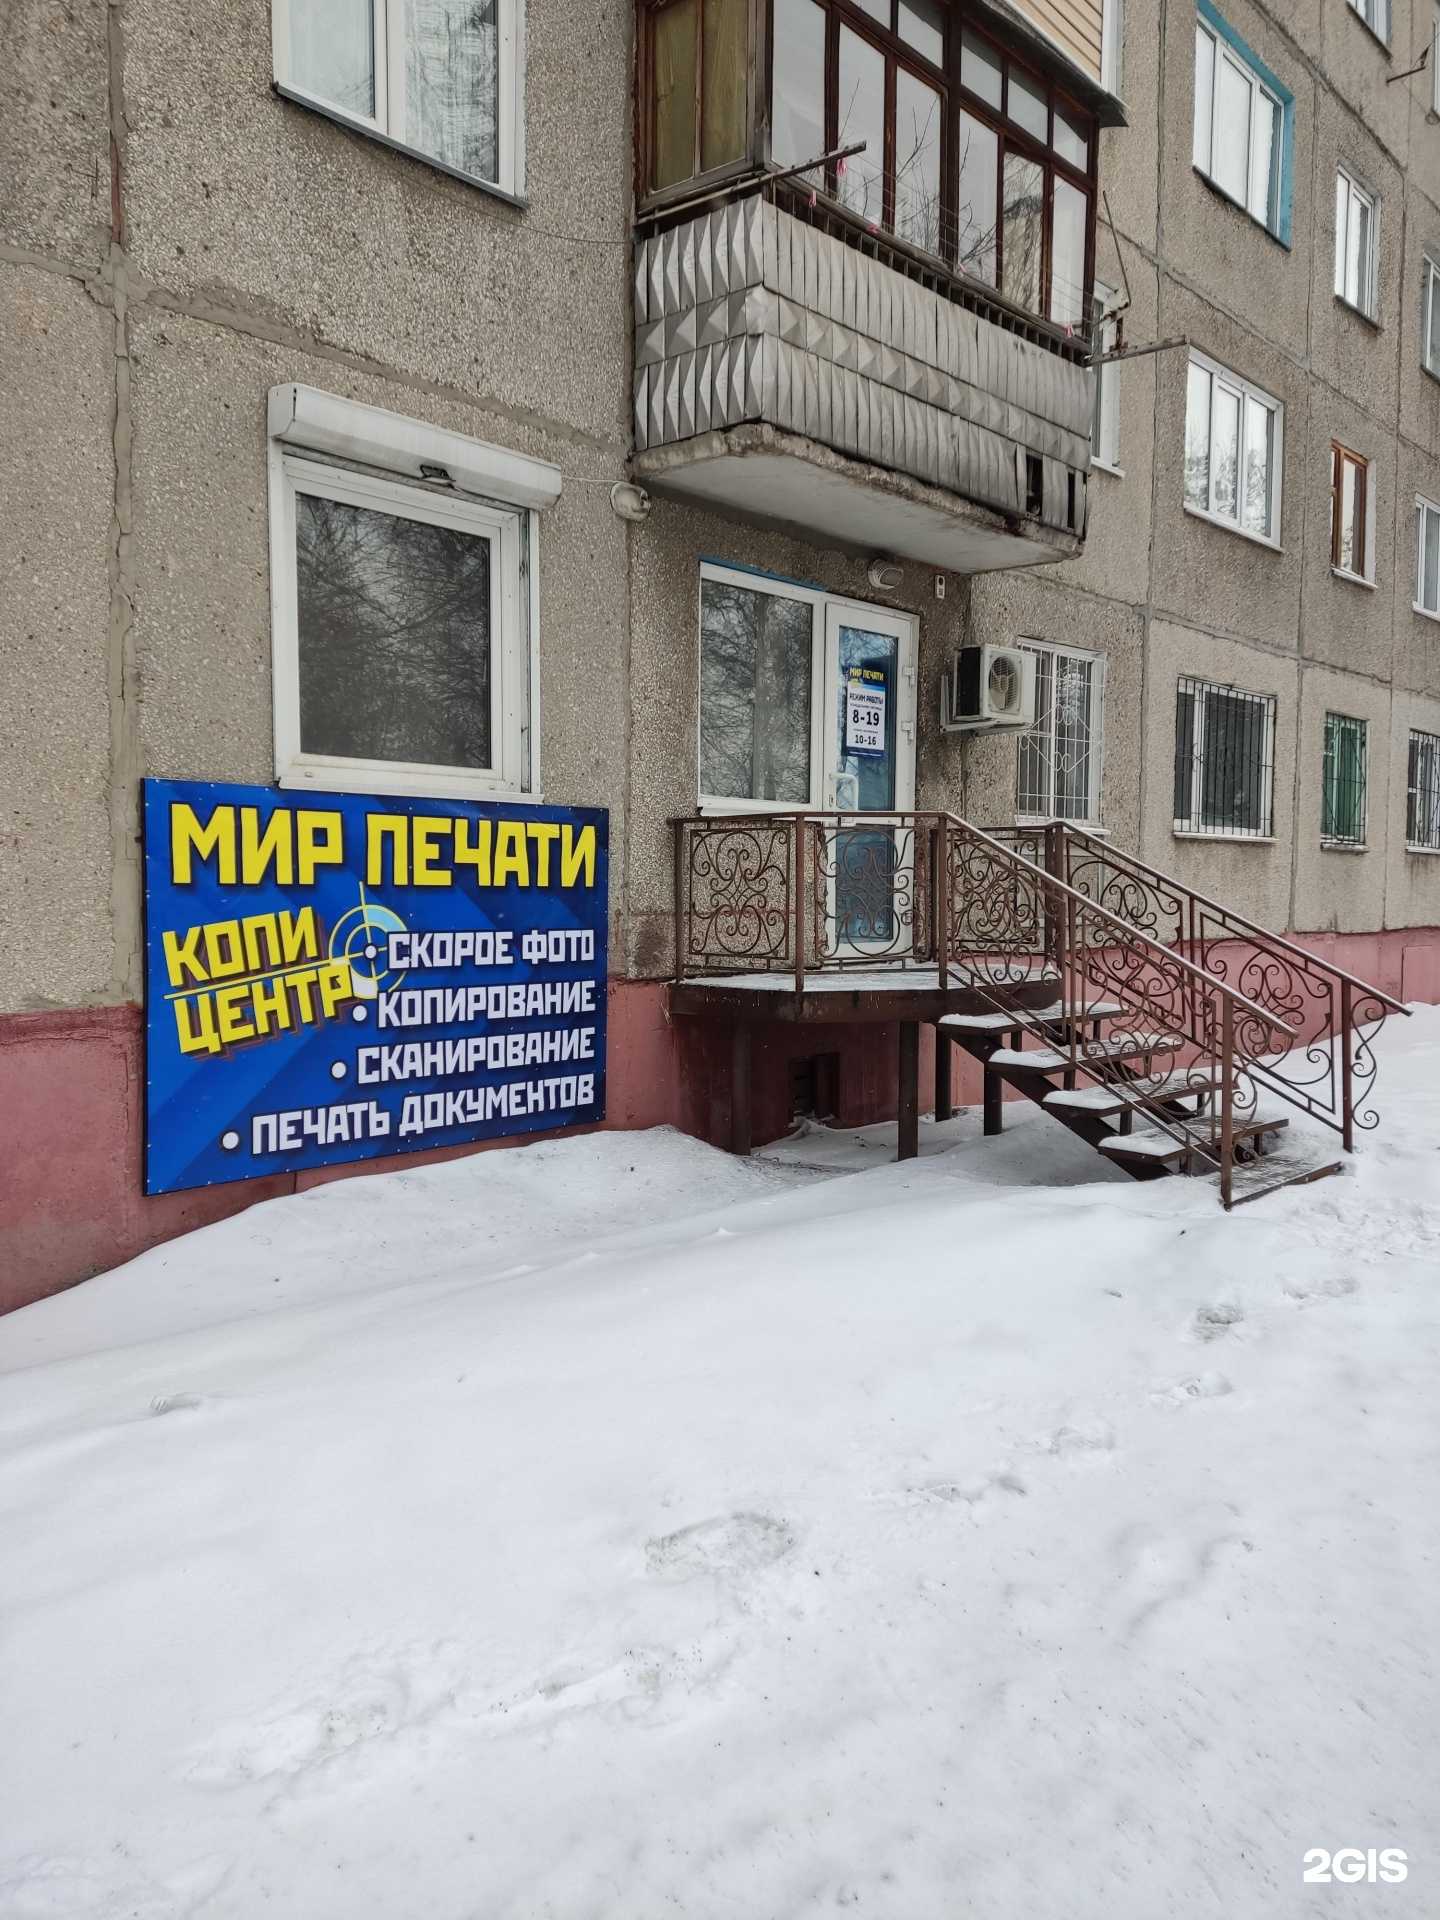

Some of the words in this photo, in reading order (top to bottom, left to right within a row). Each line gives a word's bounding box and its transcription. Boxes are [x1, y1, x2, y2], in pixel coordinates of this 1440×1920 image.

[850, 668, 862, 678] МИР
[863, 670, 884, 681] ПЕЧАТИ
[853, 710, 879, 726] 8-19
[855, 734, 877, 746] 10-16
[171, 803, 343, 885] МИР
[366, 814, 595, 887] ПЕЧАТИ
[162, 906, 318, 987] КОПИ
[388, 931, 513, 969] СКОРОЕ
[522, 929, 595, 965] ФОТО
[173, 962, 353, 1054] ЦЕНТР
[378, 980, 596, 1028] КОПИРОВАНИЕ
[357, 1027, 596, 1084] СКАНИРОВАНИЕ
[252, 1101, 390, 1154] ПЕЧАТЬ
[398, 1073, 595, 1137] ДОКУМЕНТОВ
